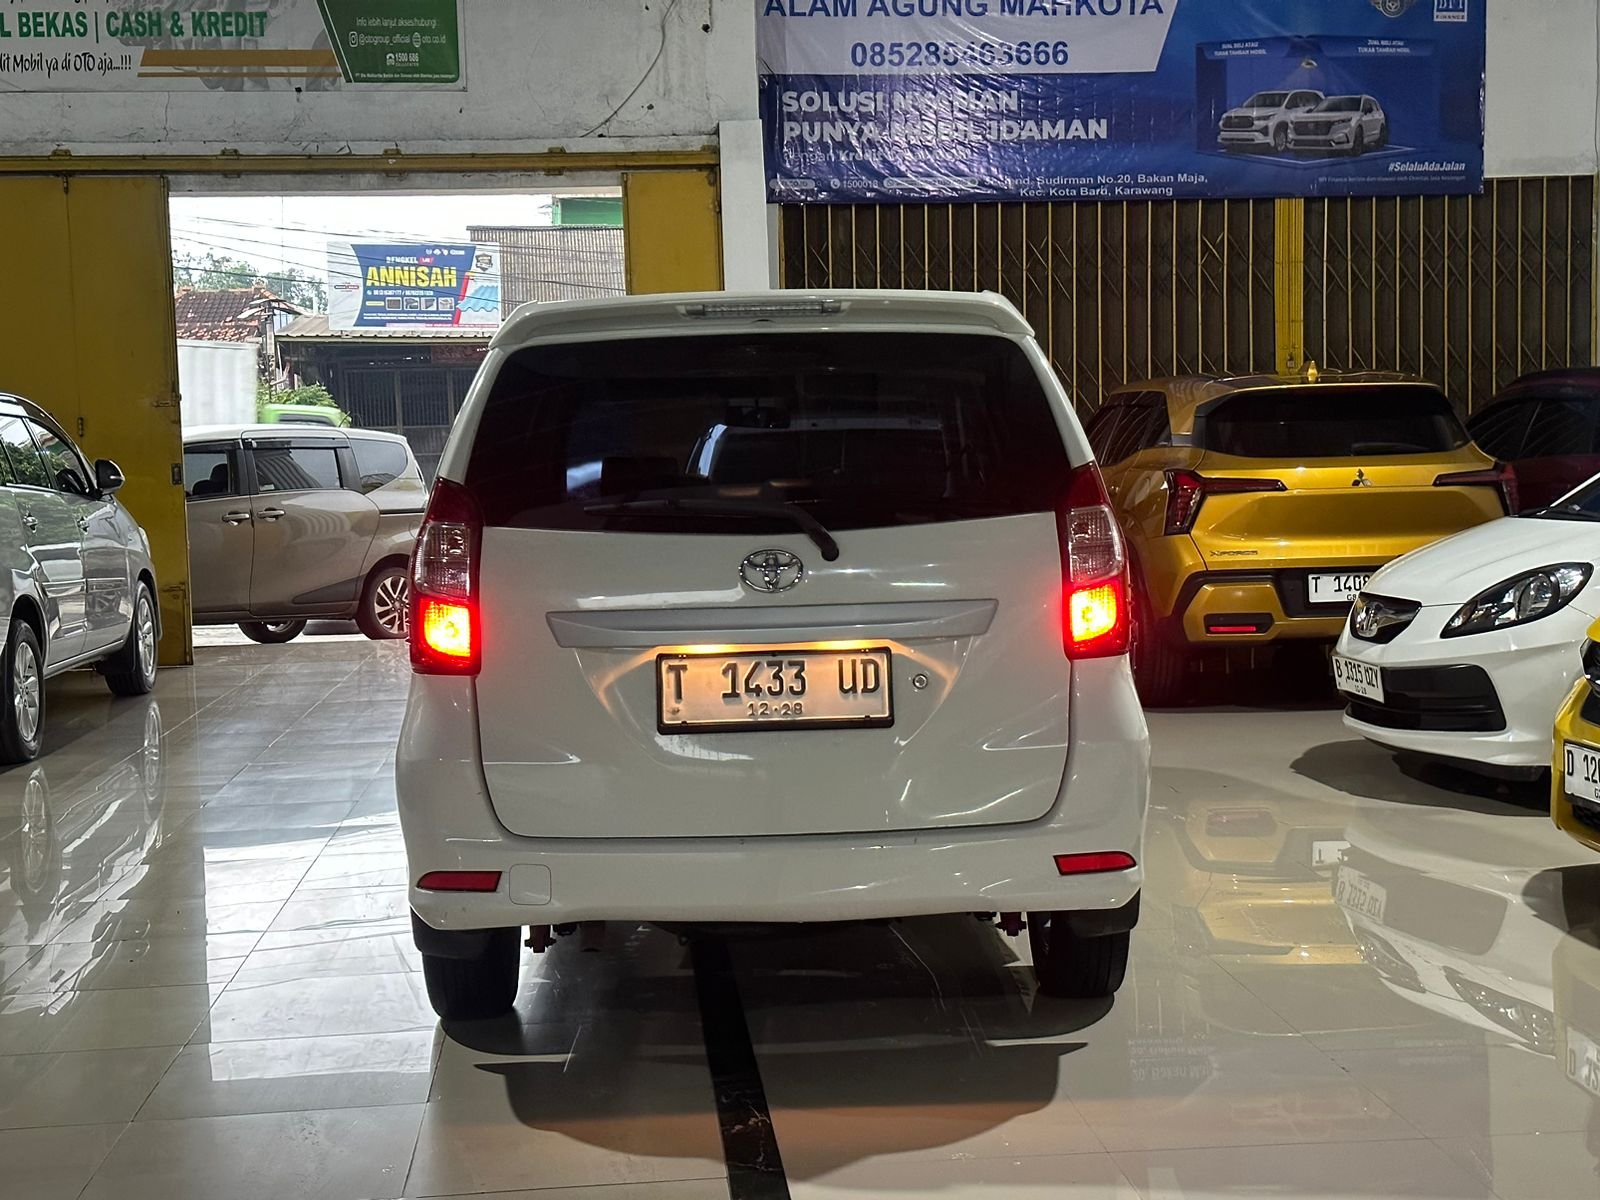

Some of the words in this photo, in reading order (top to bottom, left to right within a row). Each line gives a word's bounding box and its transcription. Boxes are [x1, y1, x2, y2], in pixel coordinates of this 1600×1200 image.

[763, 0, 857, 17] ALAM
[867, 0, 988, 17] AGUNG
[18, 11, 88, 38] BEKAS
[105, 11, 162, 38] CASH
[169, 11, 185, 38] &
[191, 11, 268, 38] KREDIT
[13, 52, 43, 73] Mobil
[46, 56, 59, 79] ya
[61, 52, 71, 71] di
[73, 52, 95, 71] OTO
[782, 91, 884, 113] SOLUSI
[783, 120, 881, 142] PUNYA
[990, 118, 1108, 140] IDAMAN
[1388, 161, 1467, 172] #SelaluAdaJalan
[1037, 175, 1095, 185] Sudirman
[1097, 174, 1134, 186] No.20,
[1138, 174, 1174, 184] Bakan
[1177, 173, 1209, 184] Maja,
[1020, 187, 1046, 197] Kec.
[1050, 187, 1077, 196] Kota
[1115, 186, 1173, 197] Karawang
[366, 266, 458, 288] ANNISAH
[1311, 576, 1321, 593] T
[667, 663, 689, 700] T
[720, 659, 808, 699] 1433
[838, 658, 881, 695] UD
[1335, 658, 1343, 678] B
[1344, 660, 1364, 684] 1315
[1566, 749, 1575, 777] D
[1583, 753, 1600, 785] 12
